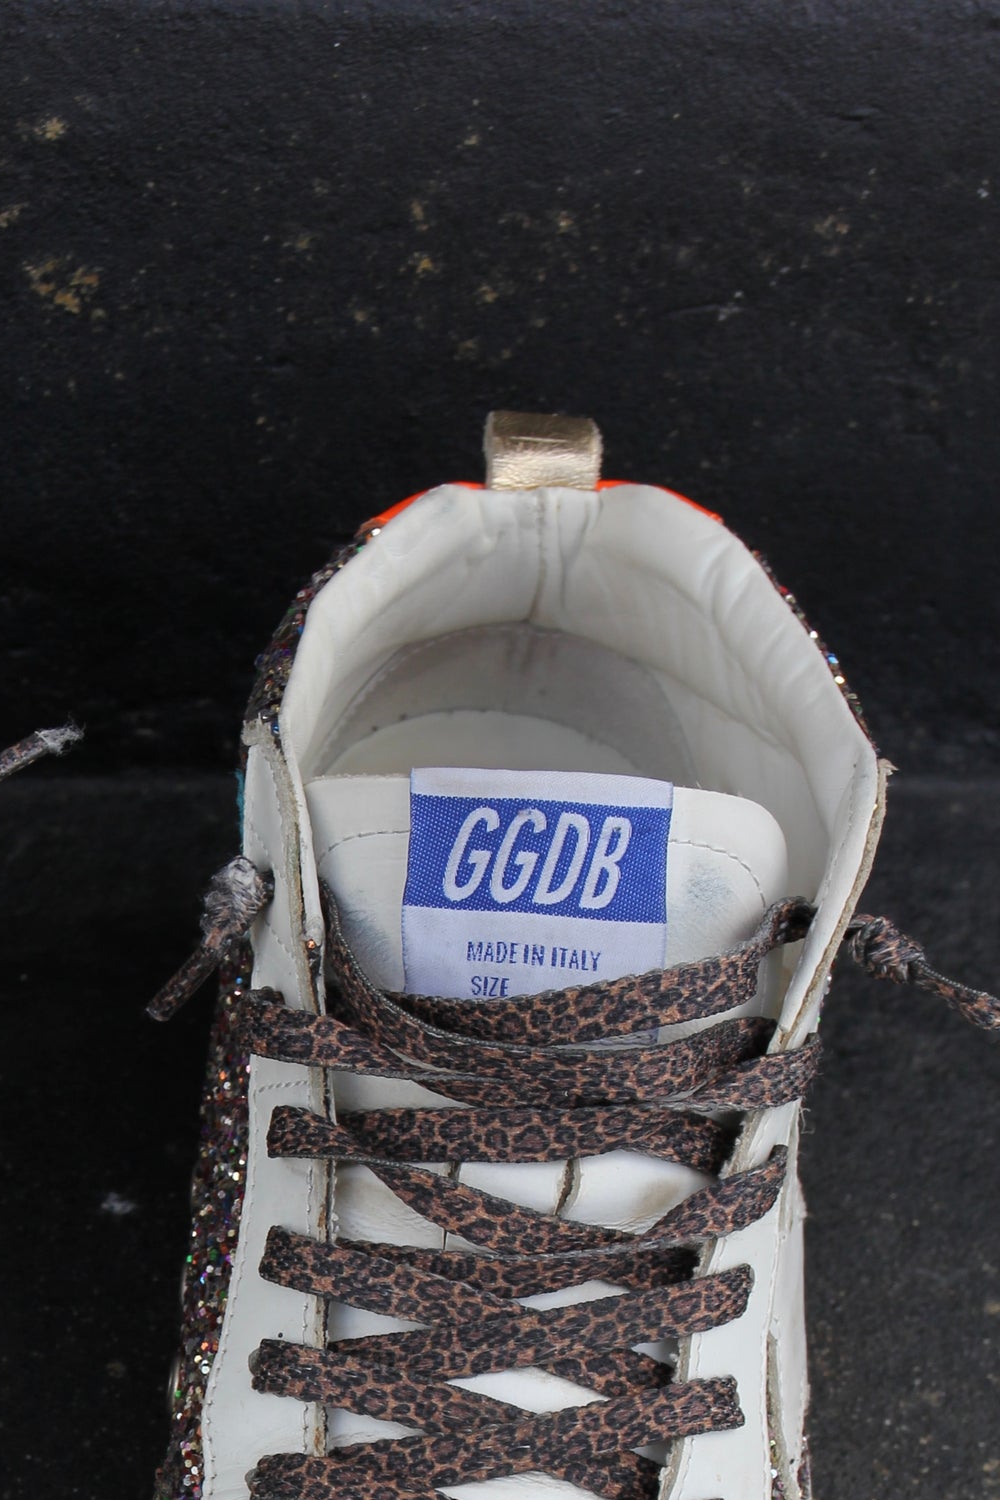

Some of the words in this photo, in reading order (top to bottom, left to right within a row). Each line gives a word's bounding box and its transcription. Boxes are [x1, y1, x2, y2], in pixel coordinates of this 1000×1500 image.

[443, 806, 632, 909] GGDB
[466, 941, 518, 964] MADE
[523, 944, 545, 966] IN
[551, 947, 602, 972] ITALY
[471, 976, 510, 997] SIZE
